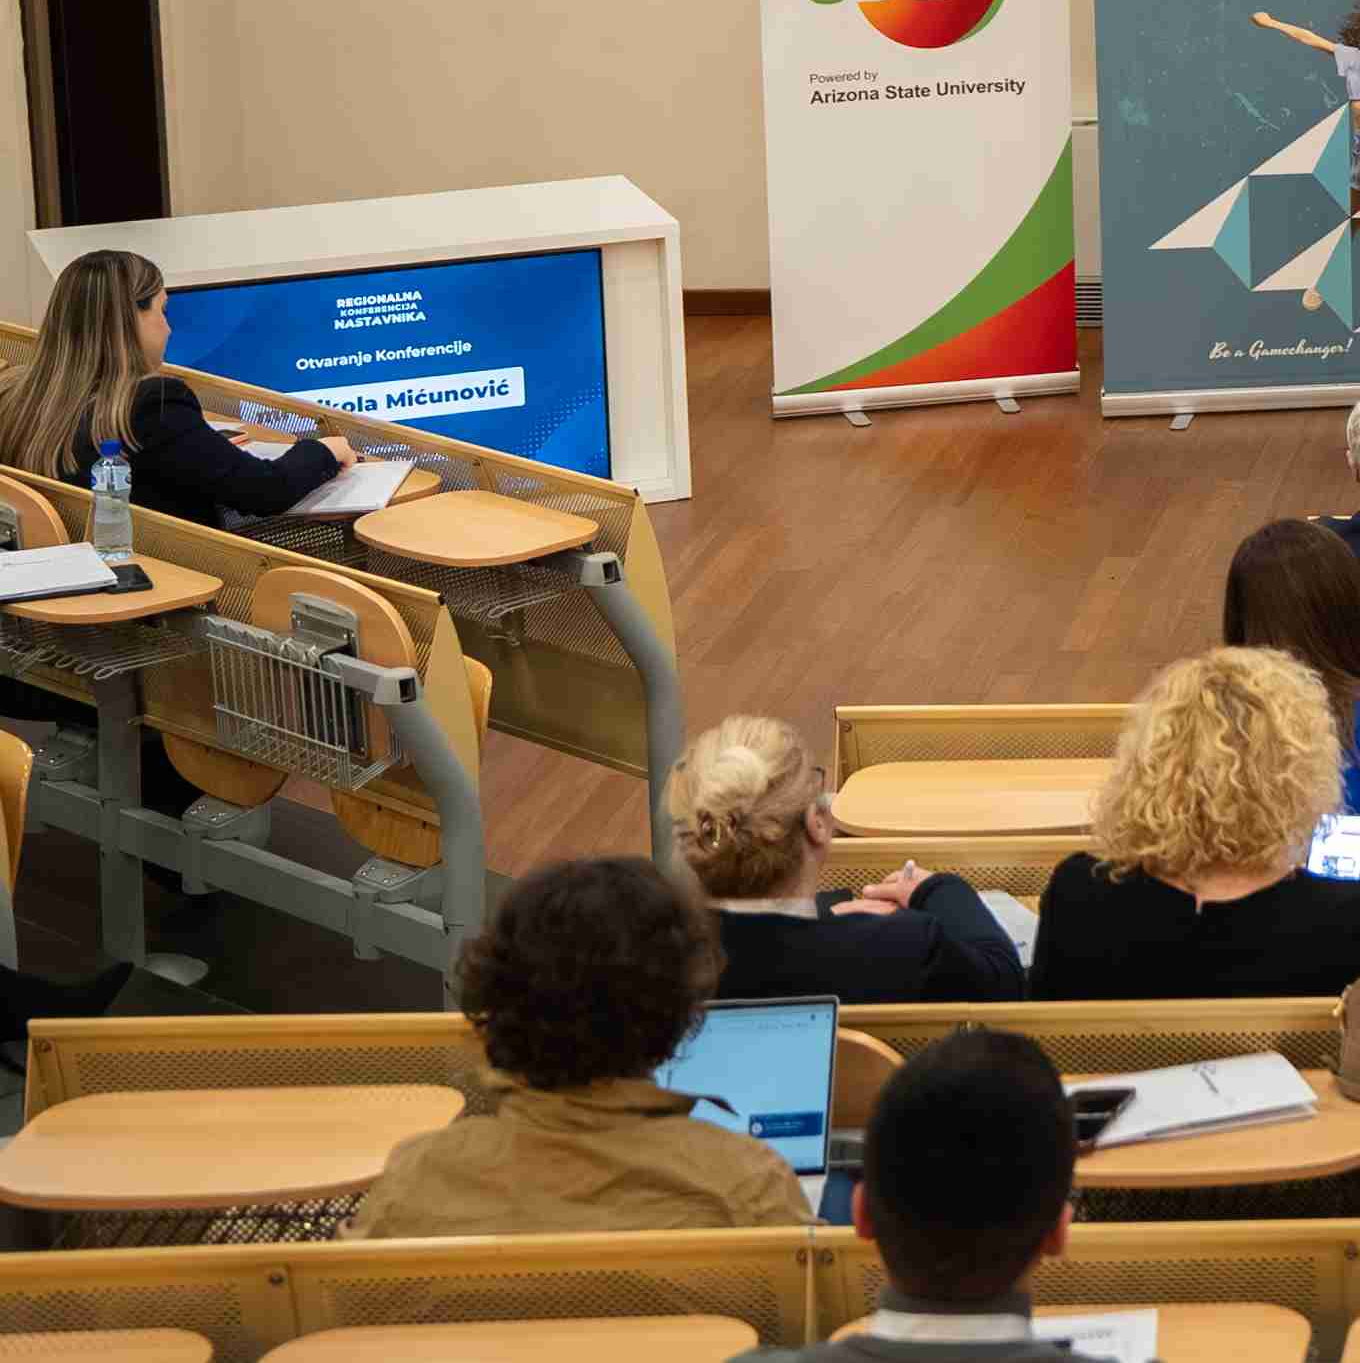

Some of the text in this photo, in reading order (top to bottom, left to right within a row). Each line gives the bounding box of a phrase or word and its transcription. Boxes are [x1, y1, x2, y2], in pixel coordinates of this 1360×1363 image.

[809, 69, 879, 84] Powered by
[810, 78, 1026, 105] Arizona State University
[336, 290, 422, 309] REGIONALNA
[340, 302, 418, 318] KONFERENCIJA
[334, 311, 426, 330] NASTAVNIKA
[295, 340, 473, 371] Otvaranje Konferencije
[1209, 337, 1354, 360] Be a Gamechanger!
[386, 379, 510, 409] Mićunović
